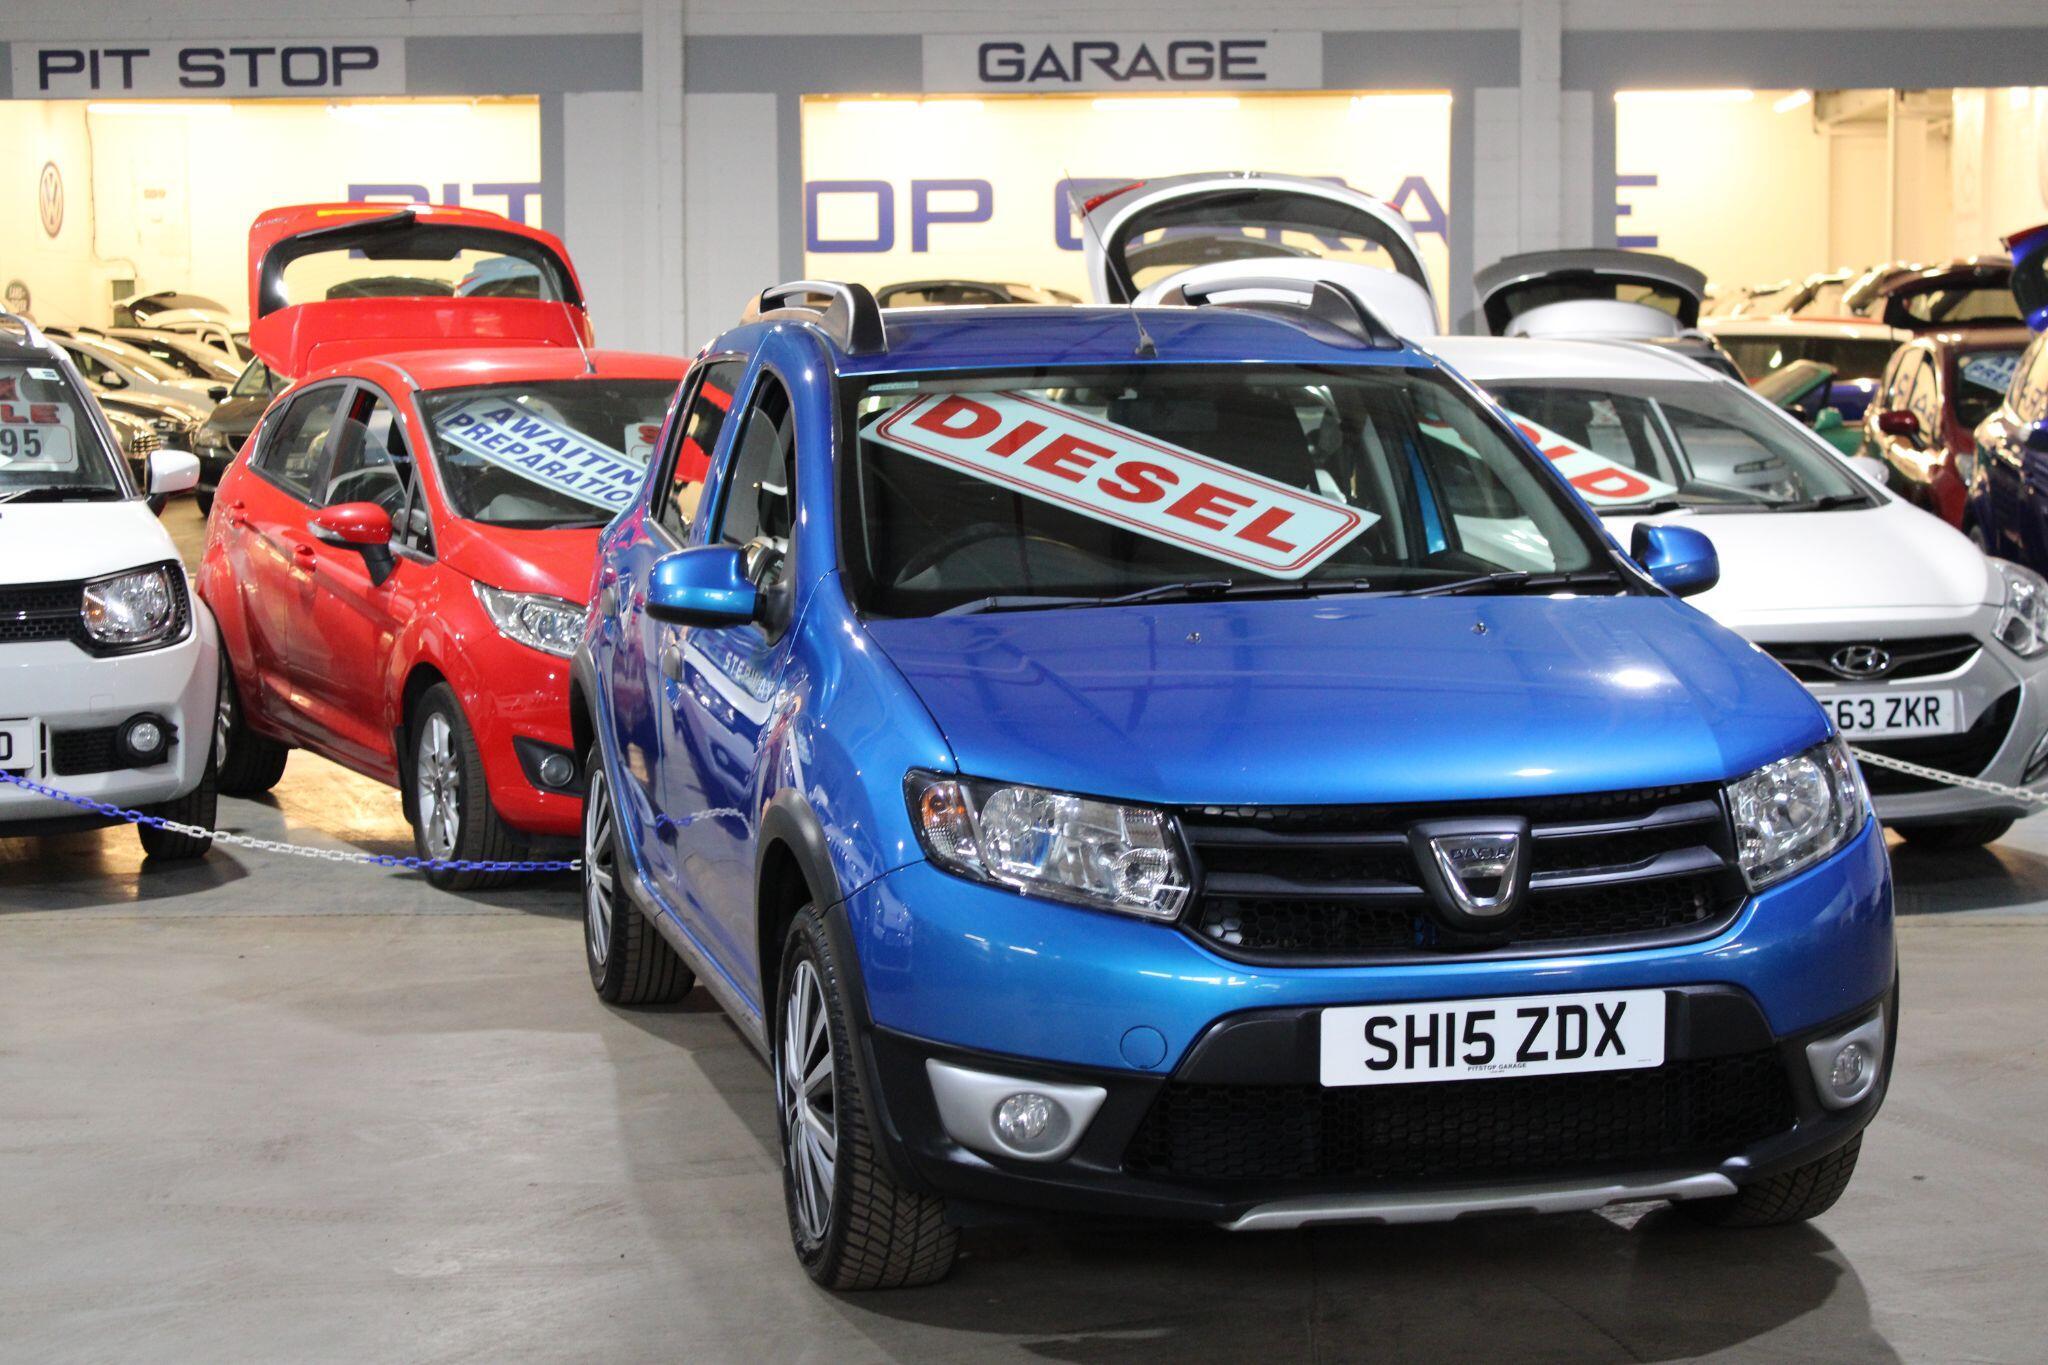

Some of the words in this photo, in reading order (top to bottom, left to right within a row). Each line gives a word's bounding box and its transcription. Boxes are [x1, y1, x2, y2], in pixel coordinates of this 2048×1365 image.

[38, 49, 150, 91] PIT
[178, 46, 380, 88] STOP
[978, 40, 1267, 82] GARAGE
[443, 412, 634, 505] PREPARATIO
[482, 407, 644, 487] AWAITIN
[911, 395, 1301, 553] DIESEL
[1885, 696, 1940, 728] ZKR
[1364, 1009, 1496, 1072] SH15
[1516, 1001, 1627, 1063] ZDX
